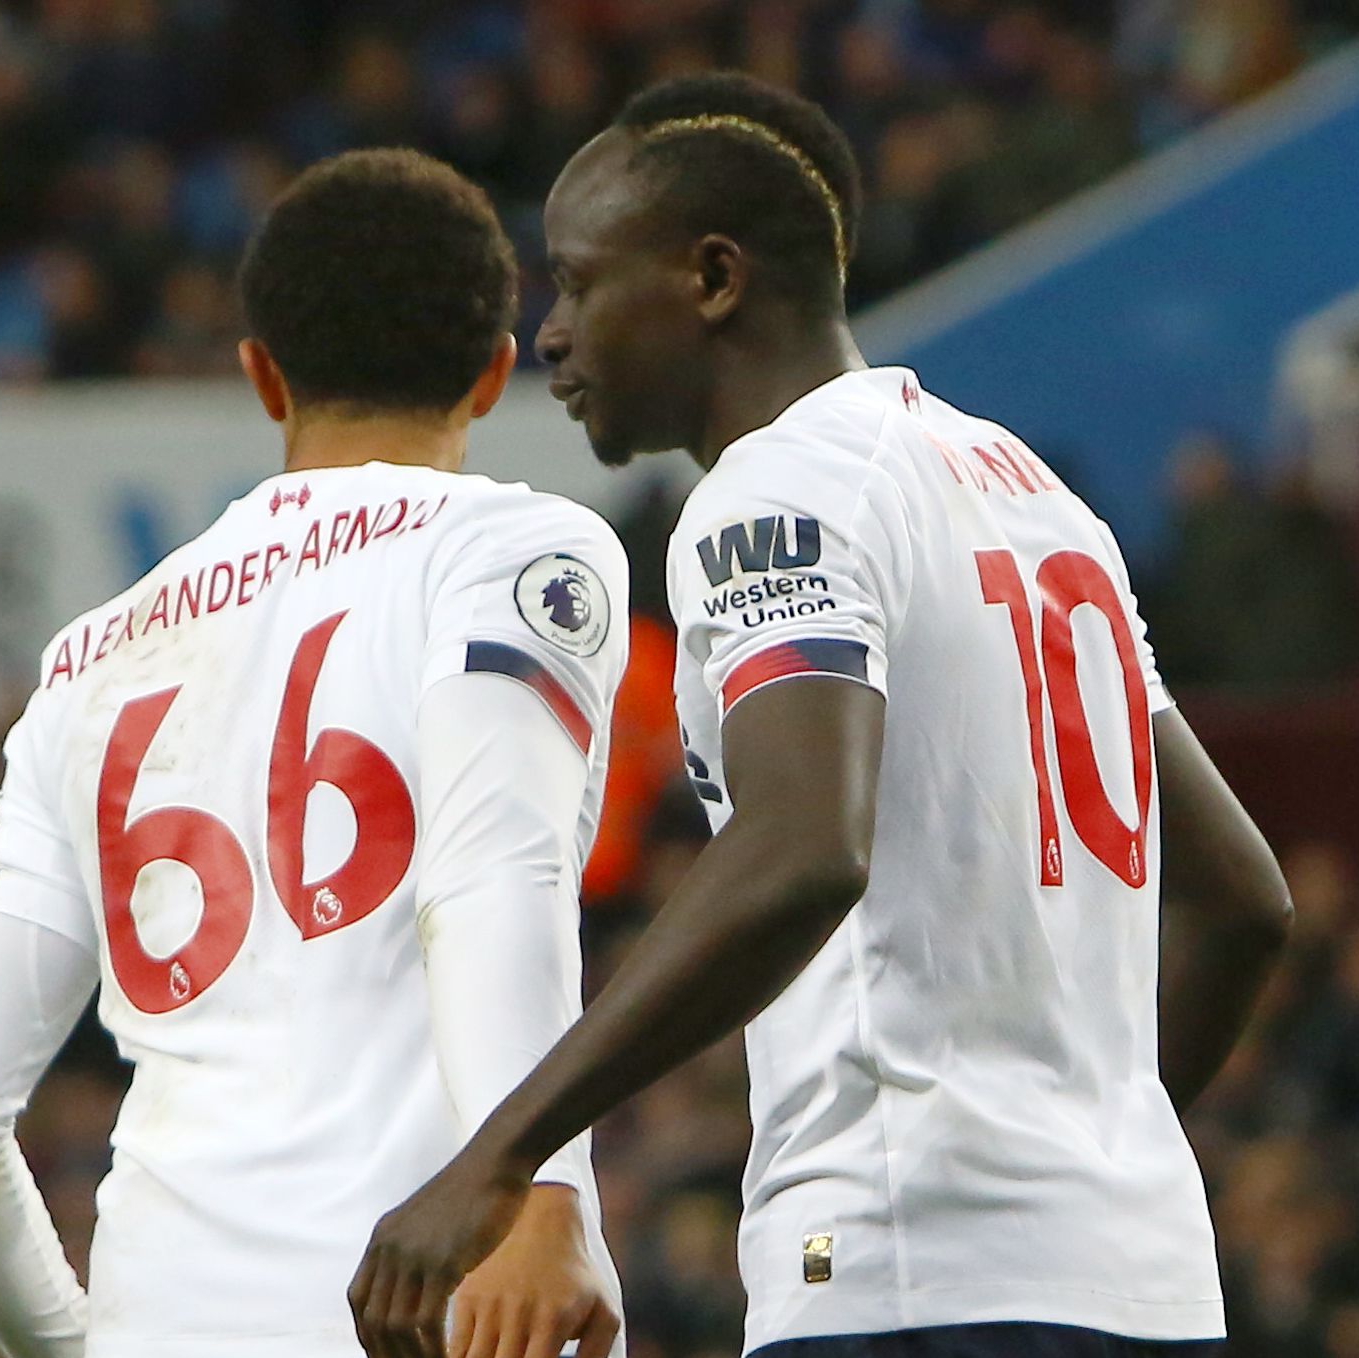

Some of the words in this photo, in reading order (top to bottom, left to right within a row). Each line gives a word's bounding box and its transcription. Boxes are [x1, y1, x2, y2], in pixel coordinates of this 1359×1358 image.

[696, 513, 821, 588] WU
[703, 575, 829, 618] Western
[742, 597, 837, 628] Union
[972, 548, 1154, 890] 10
[96, 607, 418, 1016] 66
